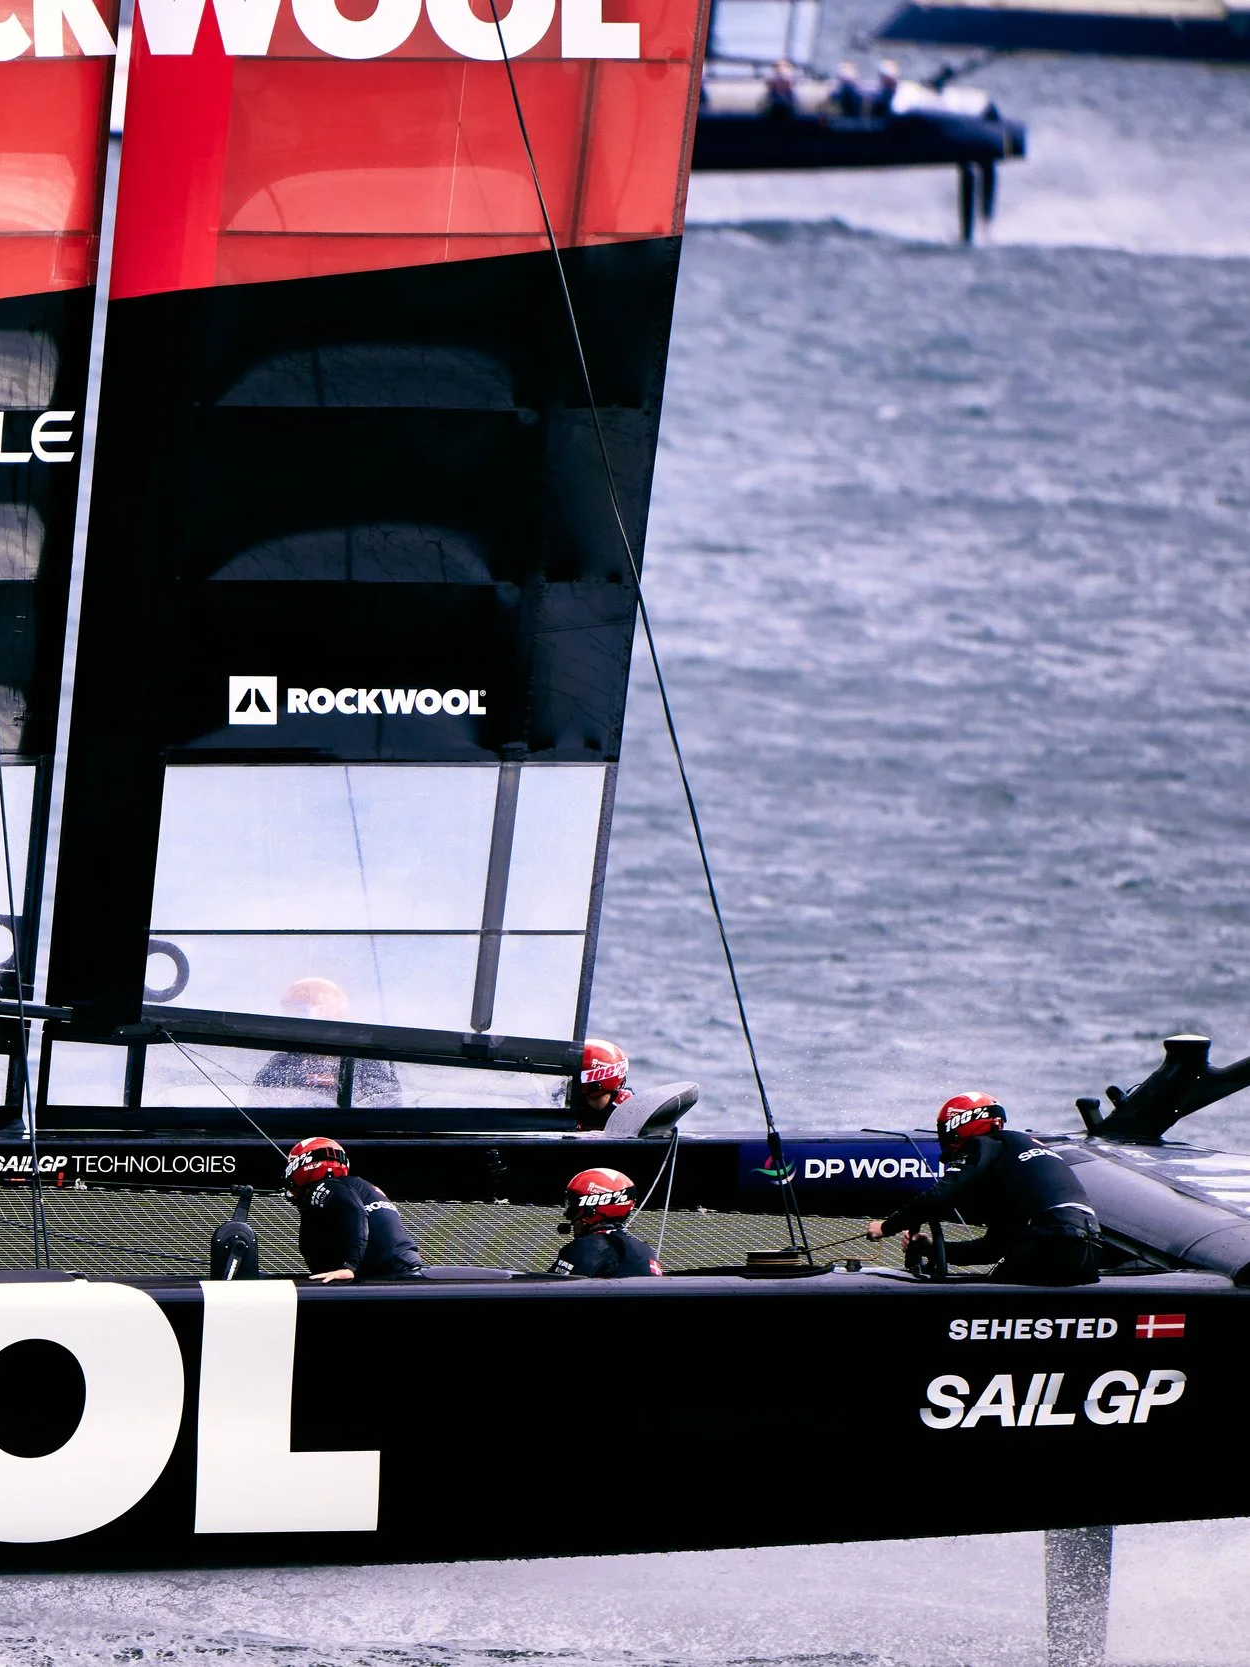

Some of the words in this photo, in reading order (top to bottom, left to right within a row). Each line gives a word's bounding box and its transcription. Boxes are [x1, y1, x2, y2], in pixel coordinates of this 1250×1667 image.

[586, 1061, 626, 1082] 100%
[945, 1107, 989, 1132] 100%
[71, 1155, 236, 1173] TECHNOLOGIES
[805, 1158, 845, 1179] DP
[849, 1158, 945, 1179] WORL
[578, 1189, 628, 1207] 100%
[948, 1317, 1119, 1341] SEHESTED
